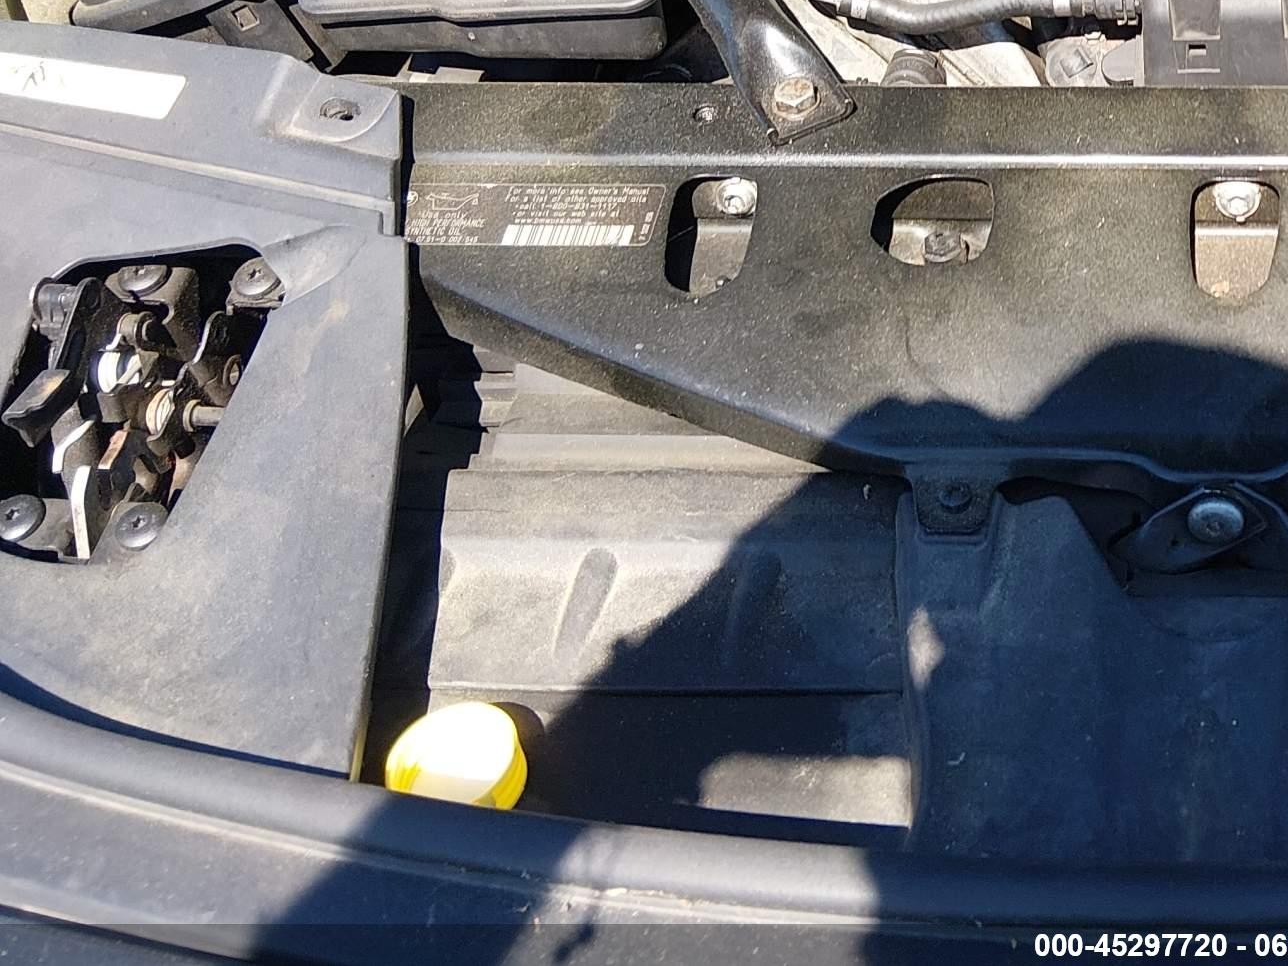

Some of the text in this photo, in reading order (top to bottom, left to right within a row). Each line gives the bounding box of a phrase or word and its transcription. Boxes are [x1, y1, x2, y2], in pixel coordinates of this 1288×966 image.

[526, 187, 545, 195] more
[587, 186, 618, 195] Owner's
[622, 186, 649, 195] Manual
[551, 195, 561, 203] of
[564, 195, 587, 203] other
[590, 195, 626, 204] approved
[445, 211, 467, 219] only
[432, 218, 486, 228] PERFORMANCE
[447, 227, 461, 235] OIL
